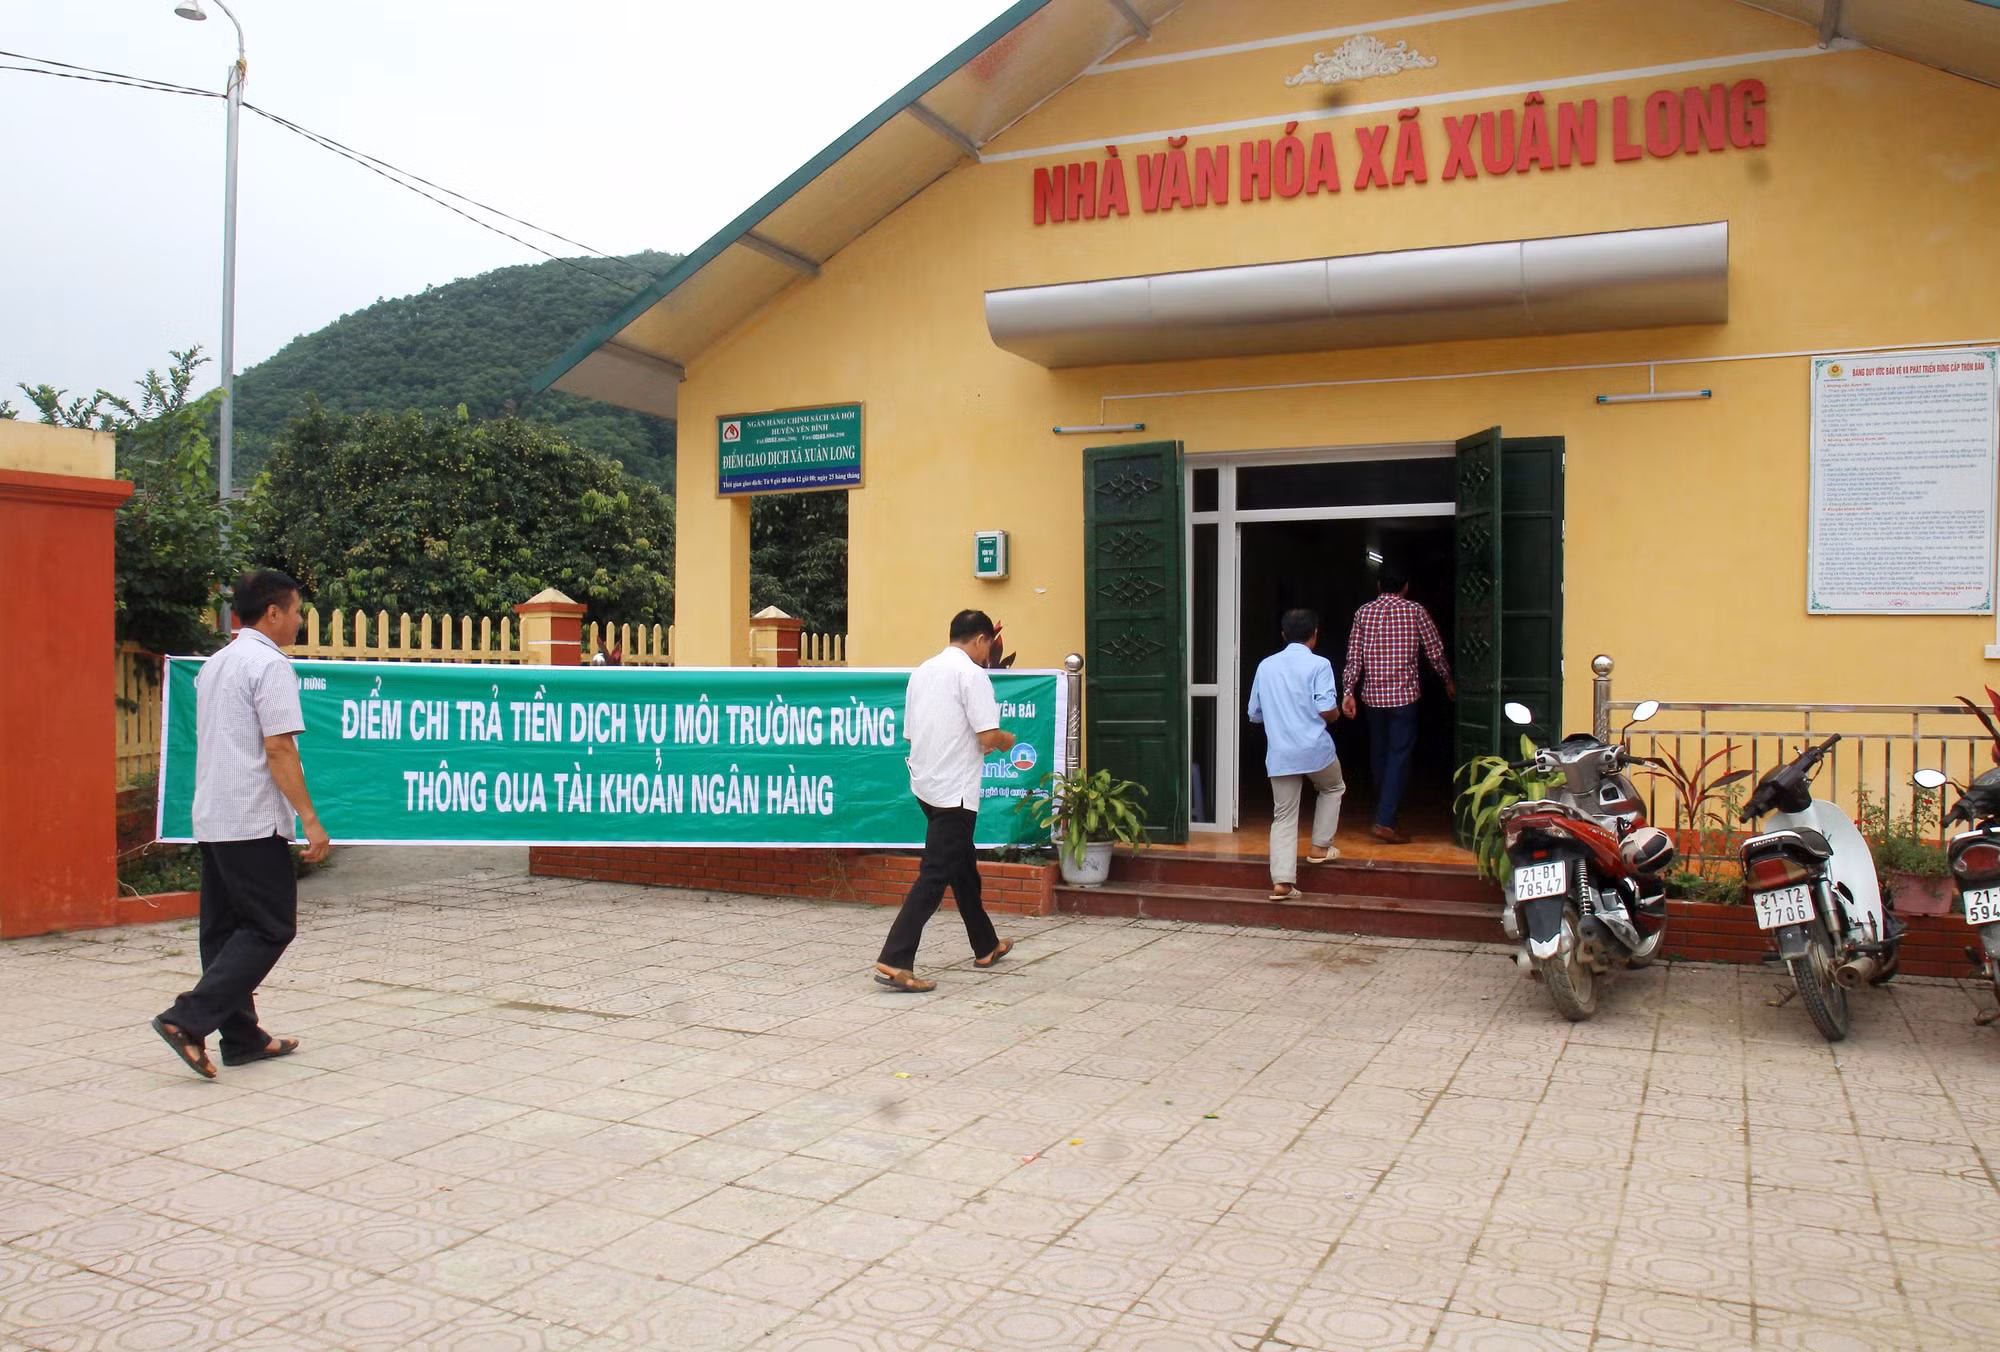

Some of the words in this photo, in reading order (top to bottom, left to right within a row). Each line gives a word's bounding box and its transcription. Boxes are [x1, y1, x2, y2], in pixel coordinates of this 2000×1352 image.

[1033, 144, 1130, 225] NHÀ
[1136, 135, 1230, 213] VĂN
[1239, 120, 1342, 202] HÓA
[1354, 106, 1428, 190] XÃ
[1441, 90, 1598, 181] XUÂN
[1612, 78, 1768, 163] LONG
[746, 419, 766, 428] NGÂN
[766, 416, 786, 426] HÀNG
[787, 415, 810, 425] CHÍNH
[810, 413, 829, 422] SÁCH
[830, 412, 840, 421] XÃ
[841, 411, 855, 420] HỘI
[796, 425, 810, 433] YÊN
[811, 423, 828, 432] BÌNH
[722, 448, 744, 469] ĐIỂM
[745, 452, 767, 467] GIAO
[767, 450, 789, 468] DỊCH
[790, 446, 803, 464] XÃ
[804, 443, 829, 462] XUÂN
[830, 445, 855, 461] LONG
[304, 675, 326, 690] RỪNG
[341, 675, 402, 740] ĐIỂM
[409, 700, 449, 741] CHI
[456, 684, 504, 742] TRẢ
[510, 684, 563, 742] TIỀN
[569, 701, 627, 756] DỊCH
[634, 702, 667, 757] VỤ
[674, 692, 720, 745] MÔI
[725, 693, 823, 746] TRƯỜNG
[830, 694, 896, 747] RỪNG
[1018, 700, 1036, 719] BÁI
[403, 759, 488, 813] THÔNG
[494, 771, 547, 814] QUA
[553, 761, 594, 814] TÀI
[599, 755, 684, 814] KHOẢN
[690, 763, 762, 815] NGÂN
[766, 763, 835, 816] HÀNG
[1522, 864, 1557, 883] 21-B1
[1518, 878, 1562, 899] 785.47
[1760, 887, 1803, 910] 21-T2
[1973, 887, 2000, 906] 21-
[1764, 905, 1806, 926] 7706
